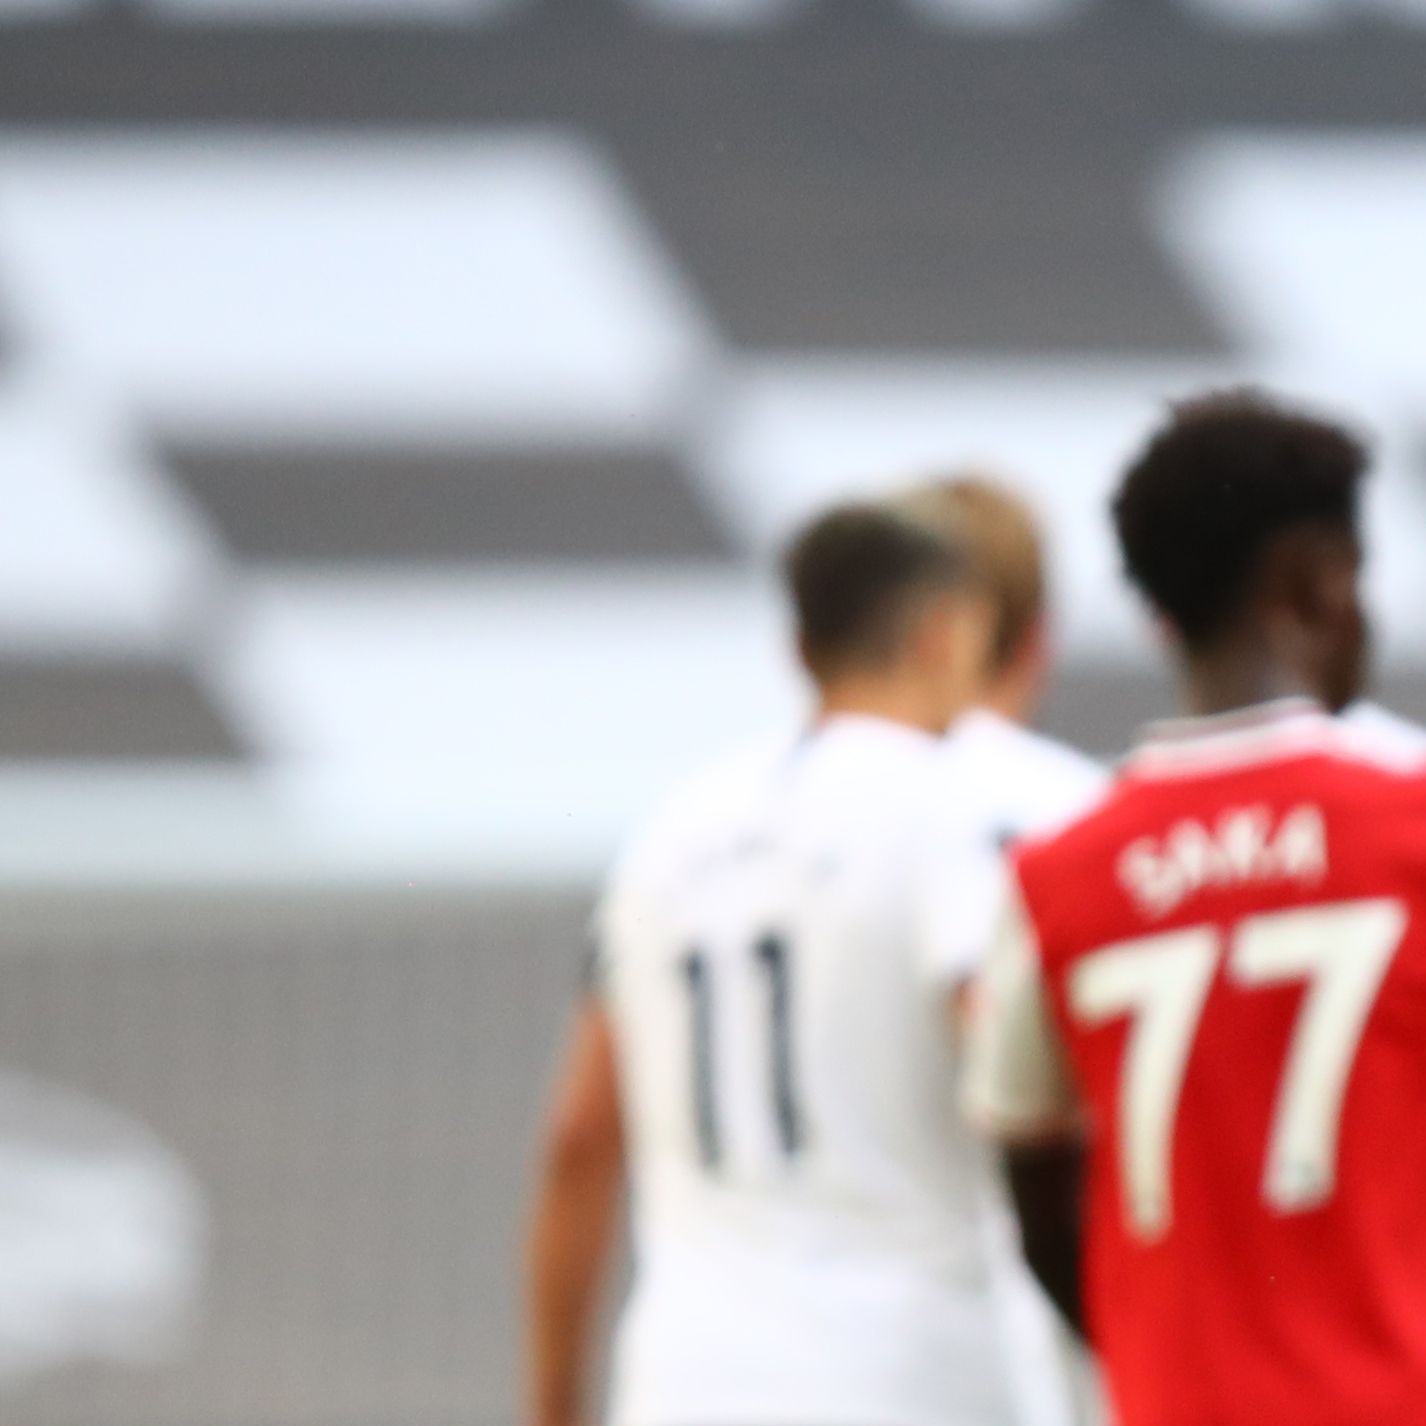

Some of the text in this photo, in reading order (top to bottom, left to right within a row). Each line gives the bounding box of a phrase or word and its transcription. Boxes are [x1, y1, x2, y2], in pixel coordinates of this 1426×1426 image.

[1114, 802, 1326, 918] SAKA
[682, 932, 806, 1172] 11
[1068, 896, 1406, 1246] 77
